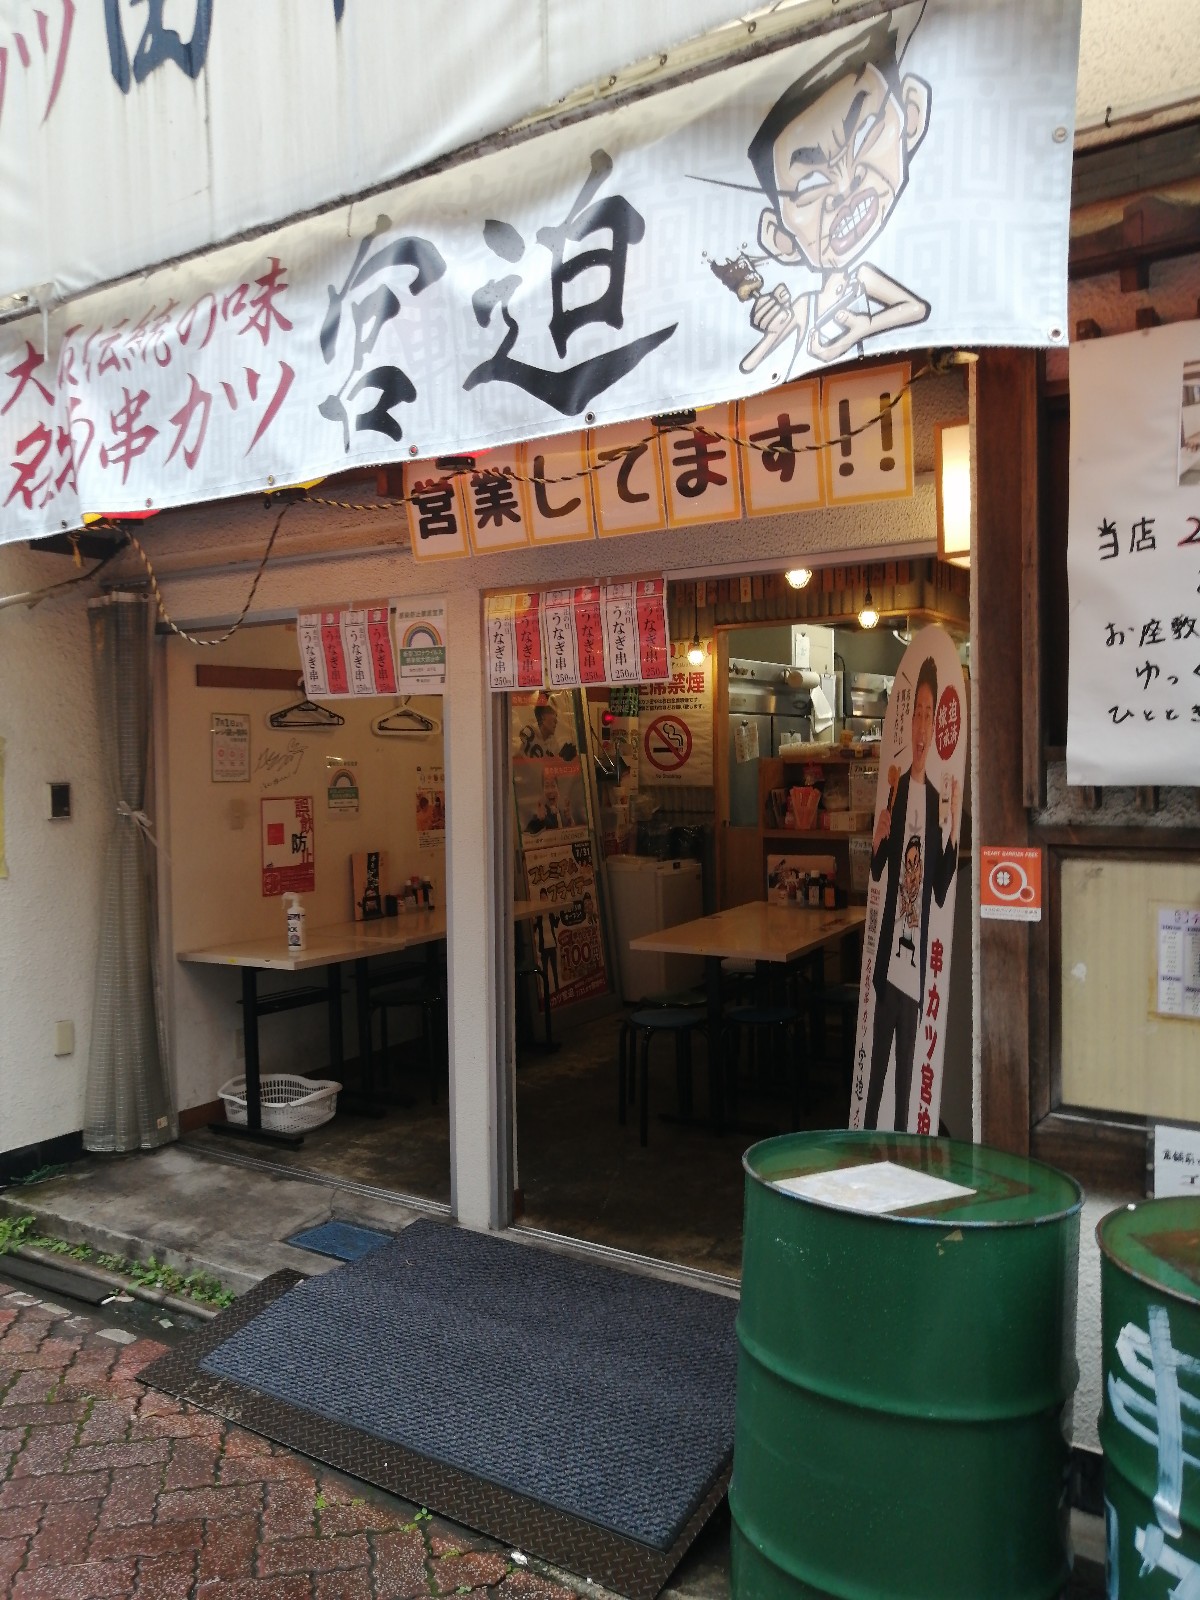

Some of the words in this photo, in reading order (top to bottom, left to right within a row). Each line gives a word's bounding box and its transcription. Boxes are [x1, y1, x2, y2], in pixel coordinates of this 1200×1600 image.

[1098, 517, 1156, 561] 当店
[493, 617, 506, 674] うなぎ串
[552, 612, 567, 671] うなぎ串
[612, 605, 628, 667] うなぎ串
